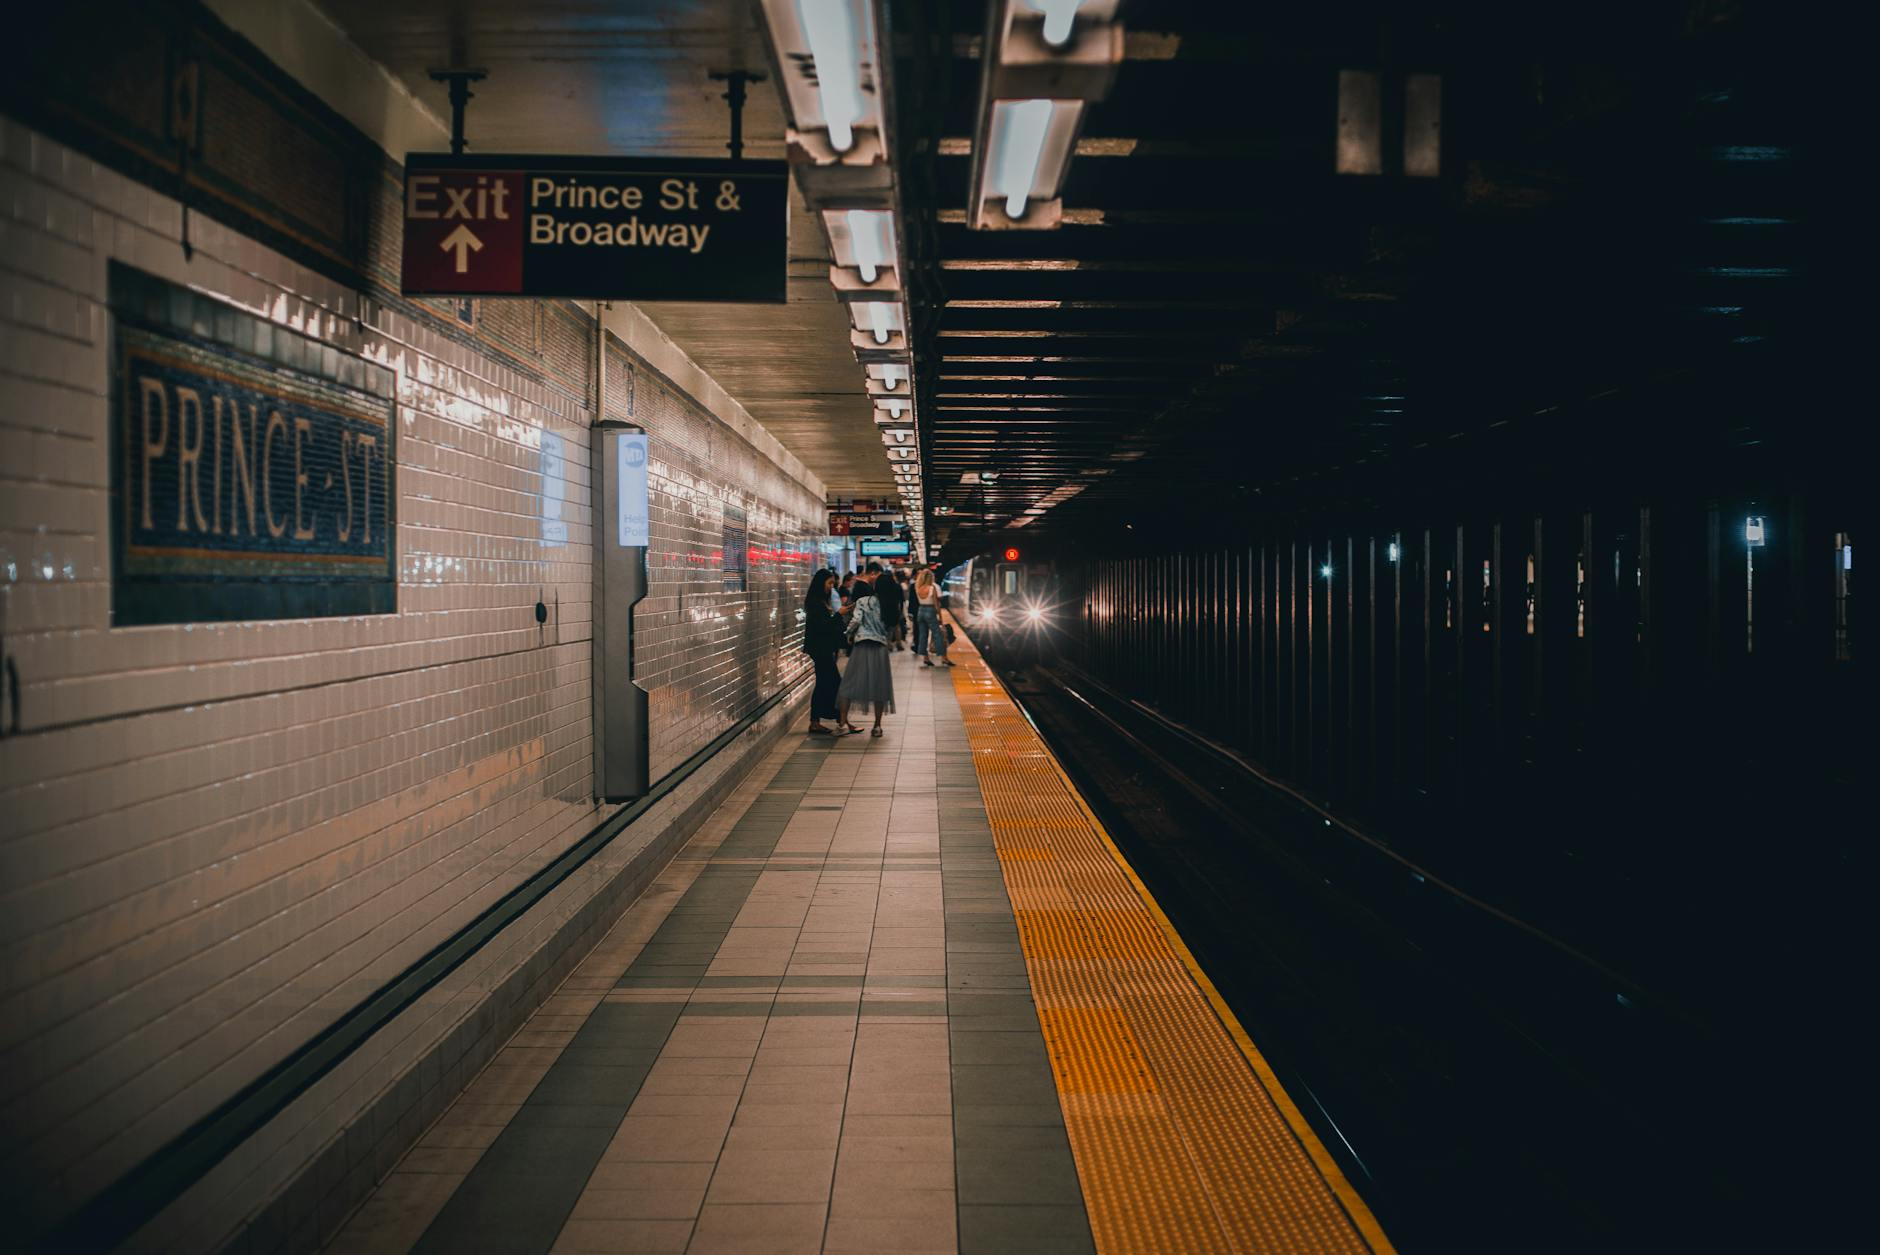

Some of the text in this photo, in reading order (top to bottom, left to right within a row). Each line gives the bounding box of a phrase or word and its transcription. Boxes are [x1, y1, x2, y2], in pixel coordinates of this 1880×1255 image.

[406, 174, 510, 220] Exit
[531, 177, 741, 211] Prince St &
[529, 213, 711, 254] Broadway
